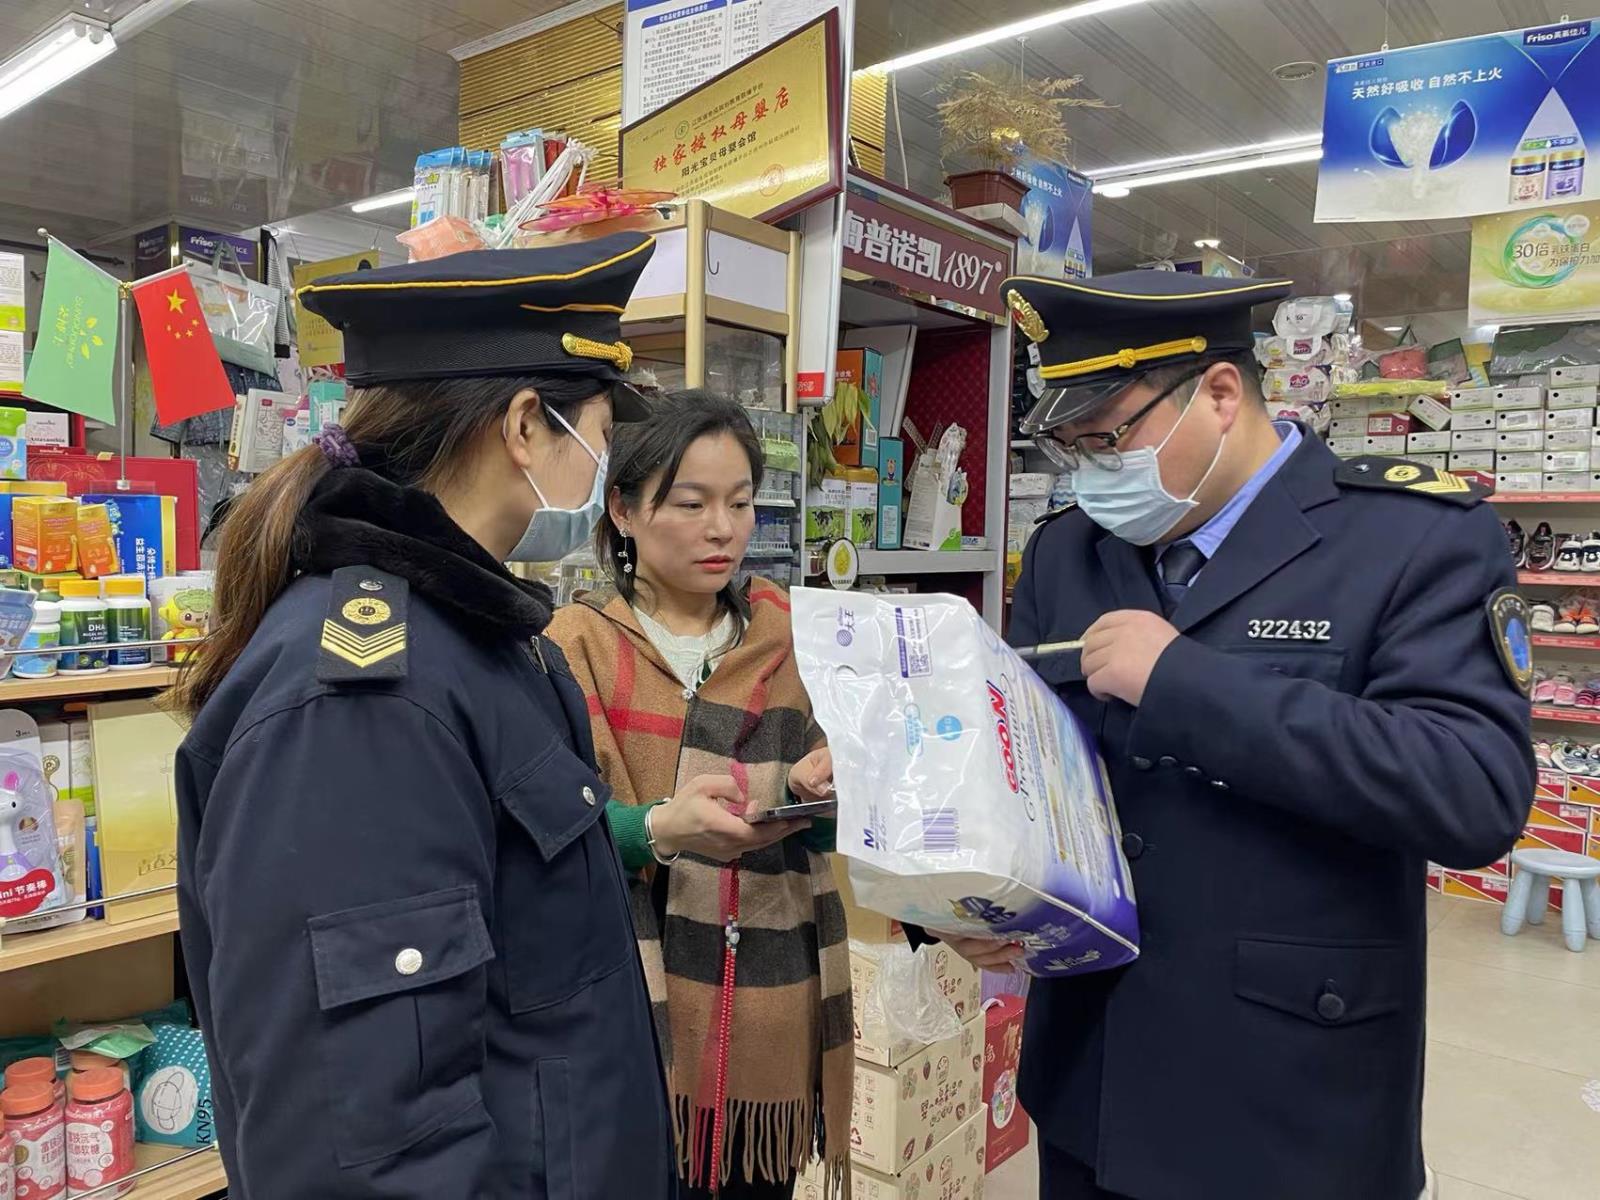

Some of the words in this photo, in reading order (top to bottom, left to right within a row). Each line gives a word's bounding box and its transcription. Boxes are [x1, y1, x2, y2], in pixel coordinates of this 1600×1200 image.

[1352, 79, 1424, 100] 天然好吸收
[1428, 67, 1503, 89] 自然不上火
[653, 86, 789, 174] 独家授权母婴店
[681, 130, 758, 178] 阳光宝贝母婴会馆
[1513, 242, 1549, 259] 30倍
[88, 624, 106, 632] DHA
[1247, 619, 1331, 640] 322432
[863, 827, 874, 848] M
[196, 1098, 212, 1145] KN95
